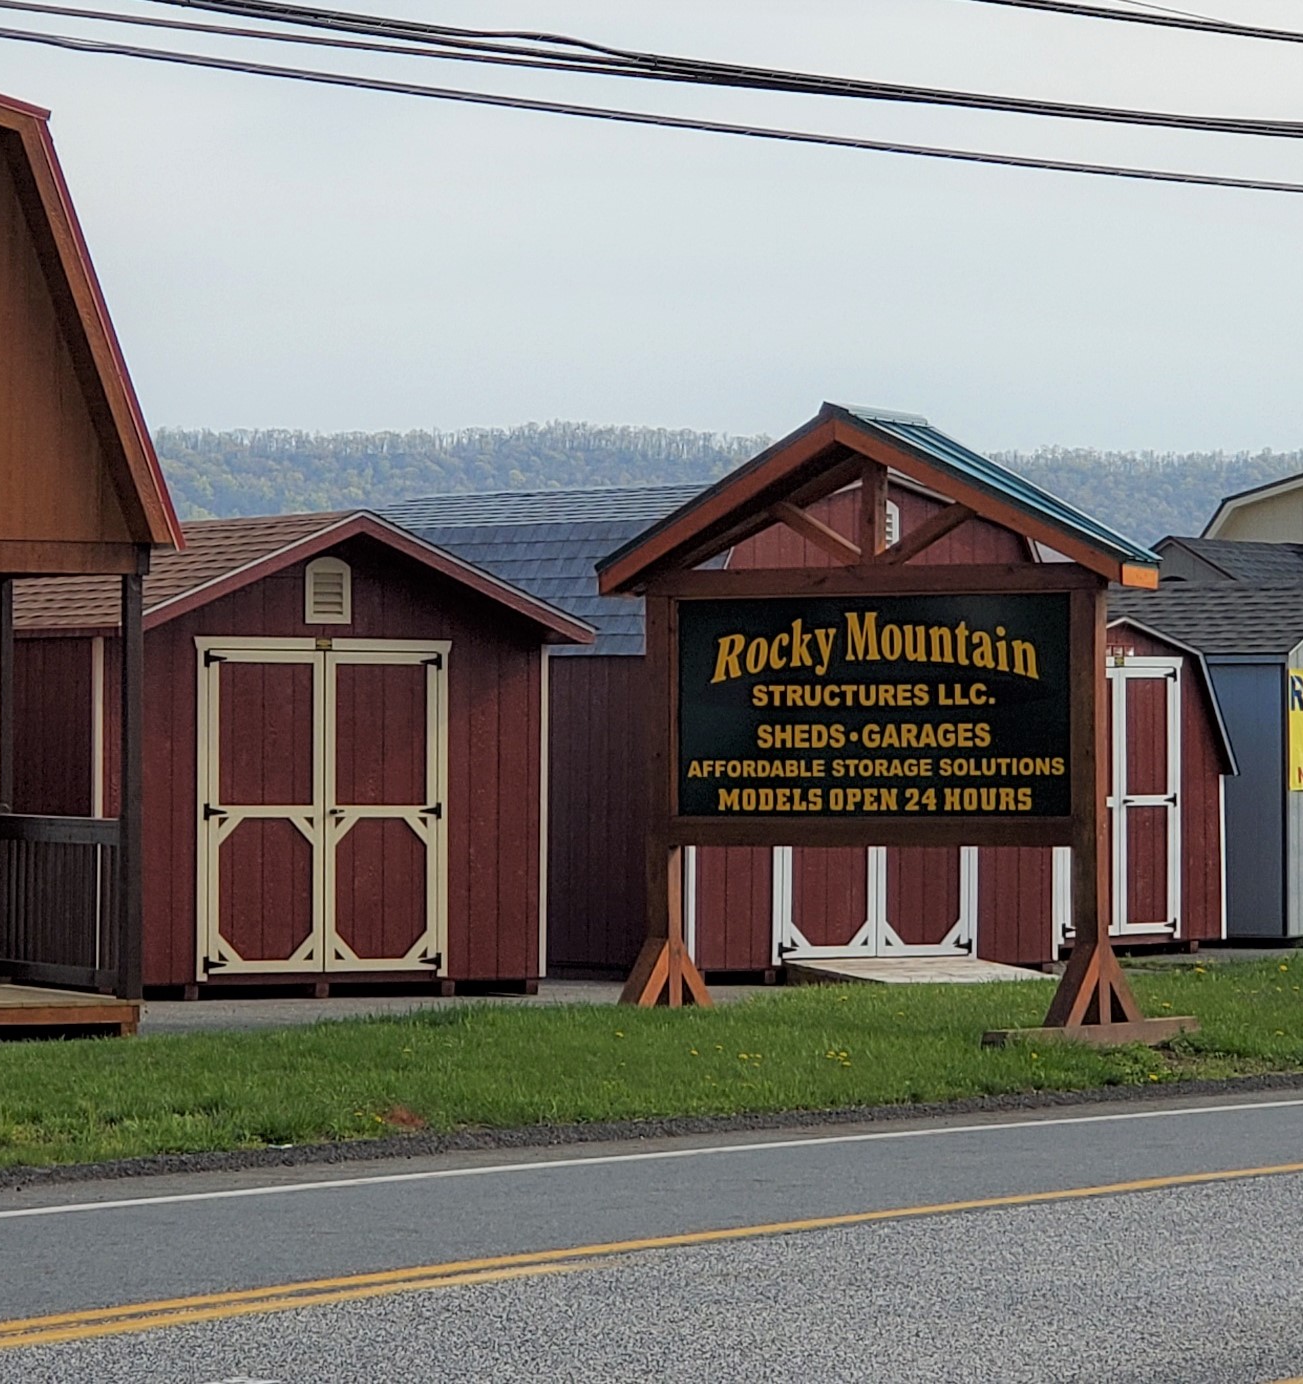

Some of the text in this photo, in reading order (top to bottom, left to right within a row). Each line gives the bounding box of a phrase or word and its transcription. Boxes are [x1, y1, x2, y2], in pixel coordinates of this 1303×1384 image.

[710, 611, 1039, 684] Rocky Mountain
[752, 683, 996, 707] STRUCTURES LLC.
[756, 722, 991, 749] SHEDS GARAGES
[687, 757, 1065, 778] AFFORDABLE STORAGE SOLUTIONS
[718, 787, 1032, 811] MODELS OPEN 24 HOURS
